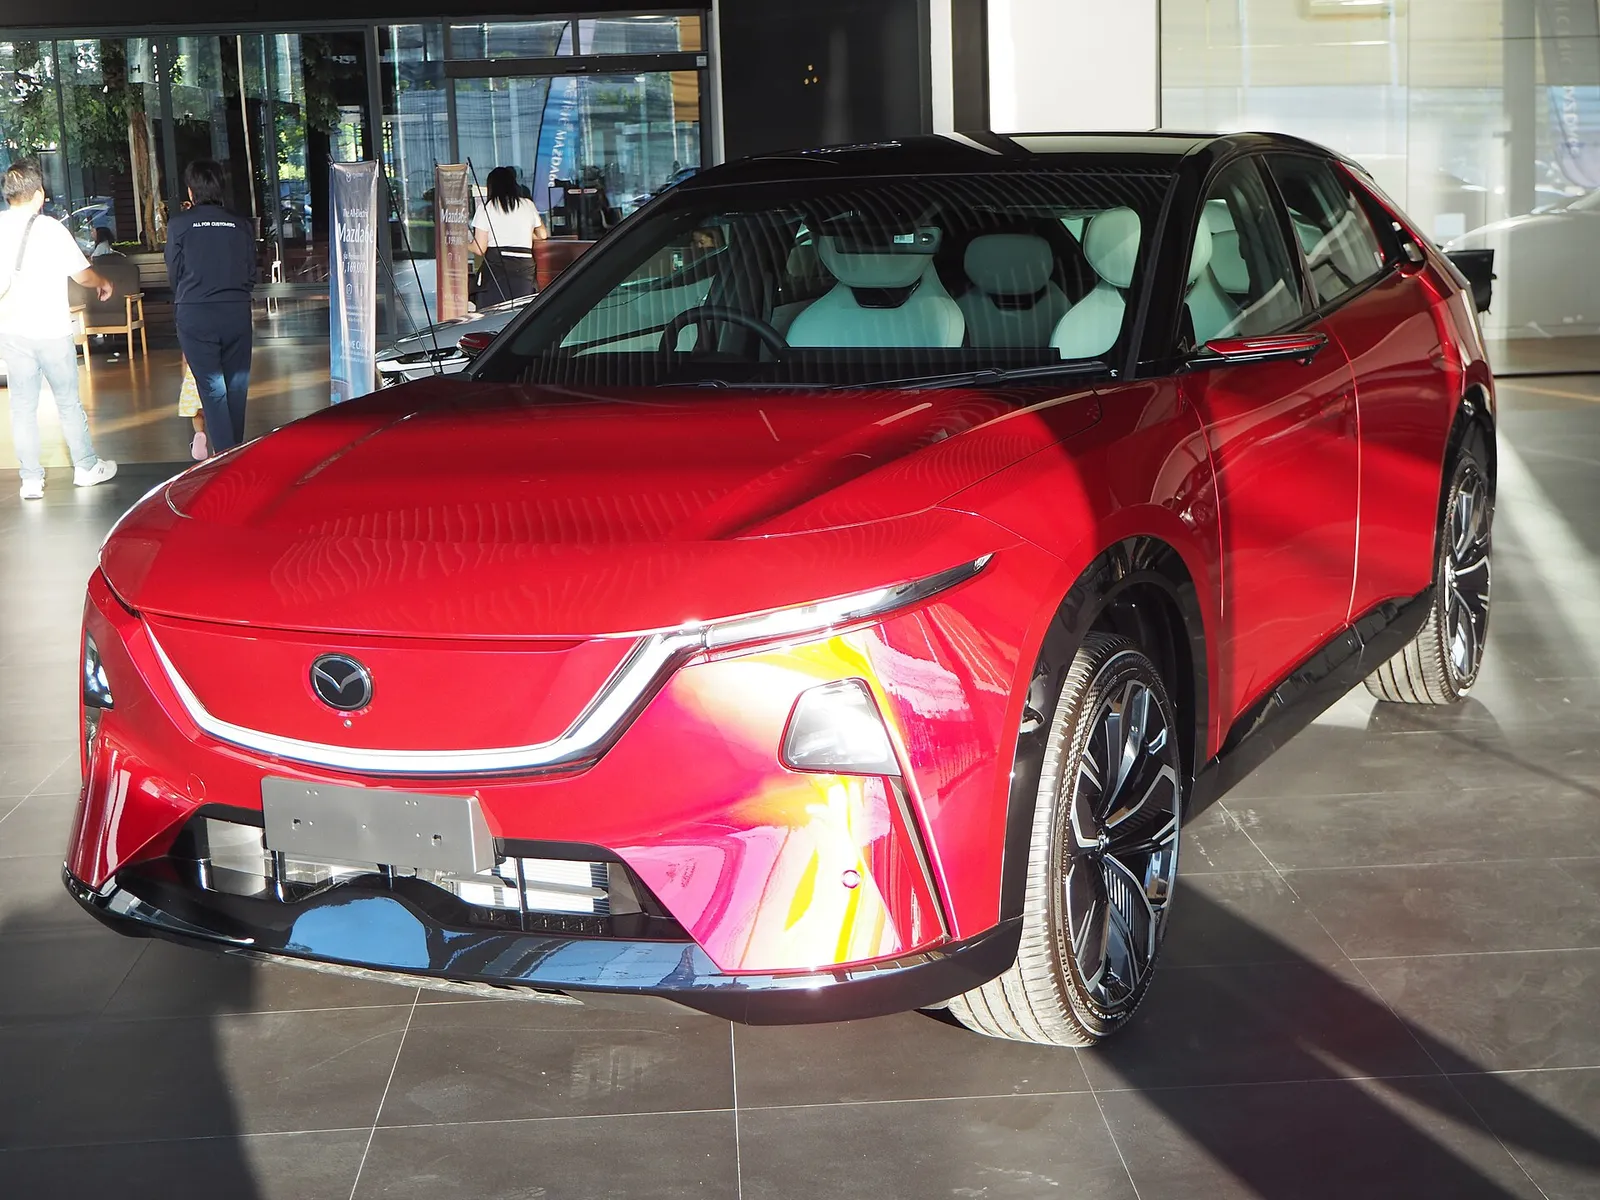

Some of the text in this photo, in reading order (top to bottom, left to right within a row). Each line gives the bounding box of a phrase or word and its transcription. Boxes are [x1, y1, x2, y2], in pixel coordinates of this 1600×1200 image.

[547, 129, 568, 188] MAZDA6e
[337, 222, 374, 244] Mazda6e
[1057, 928, 1073, 987] MICHELIN
